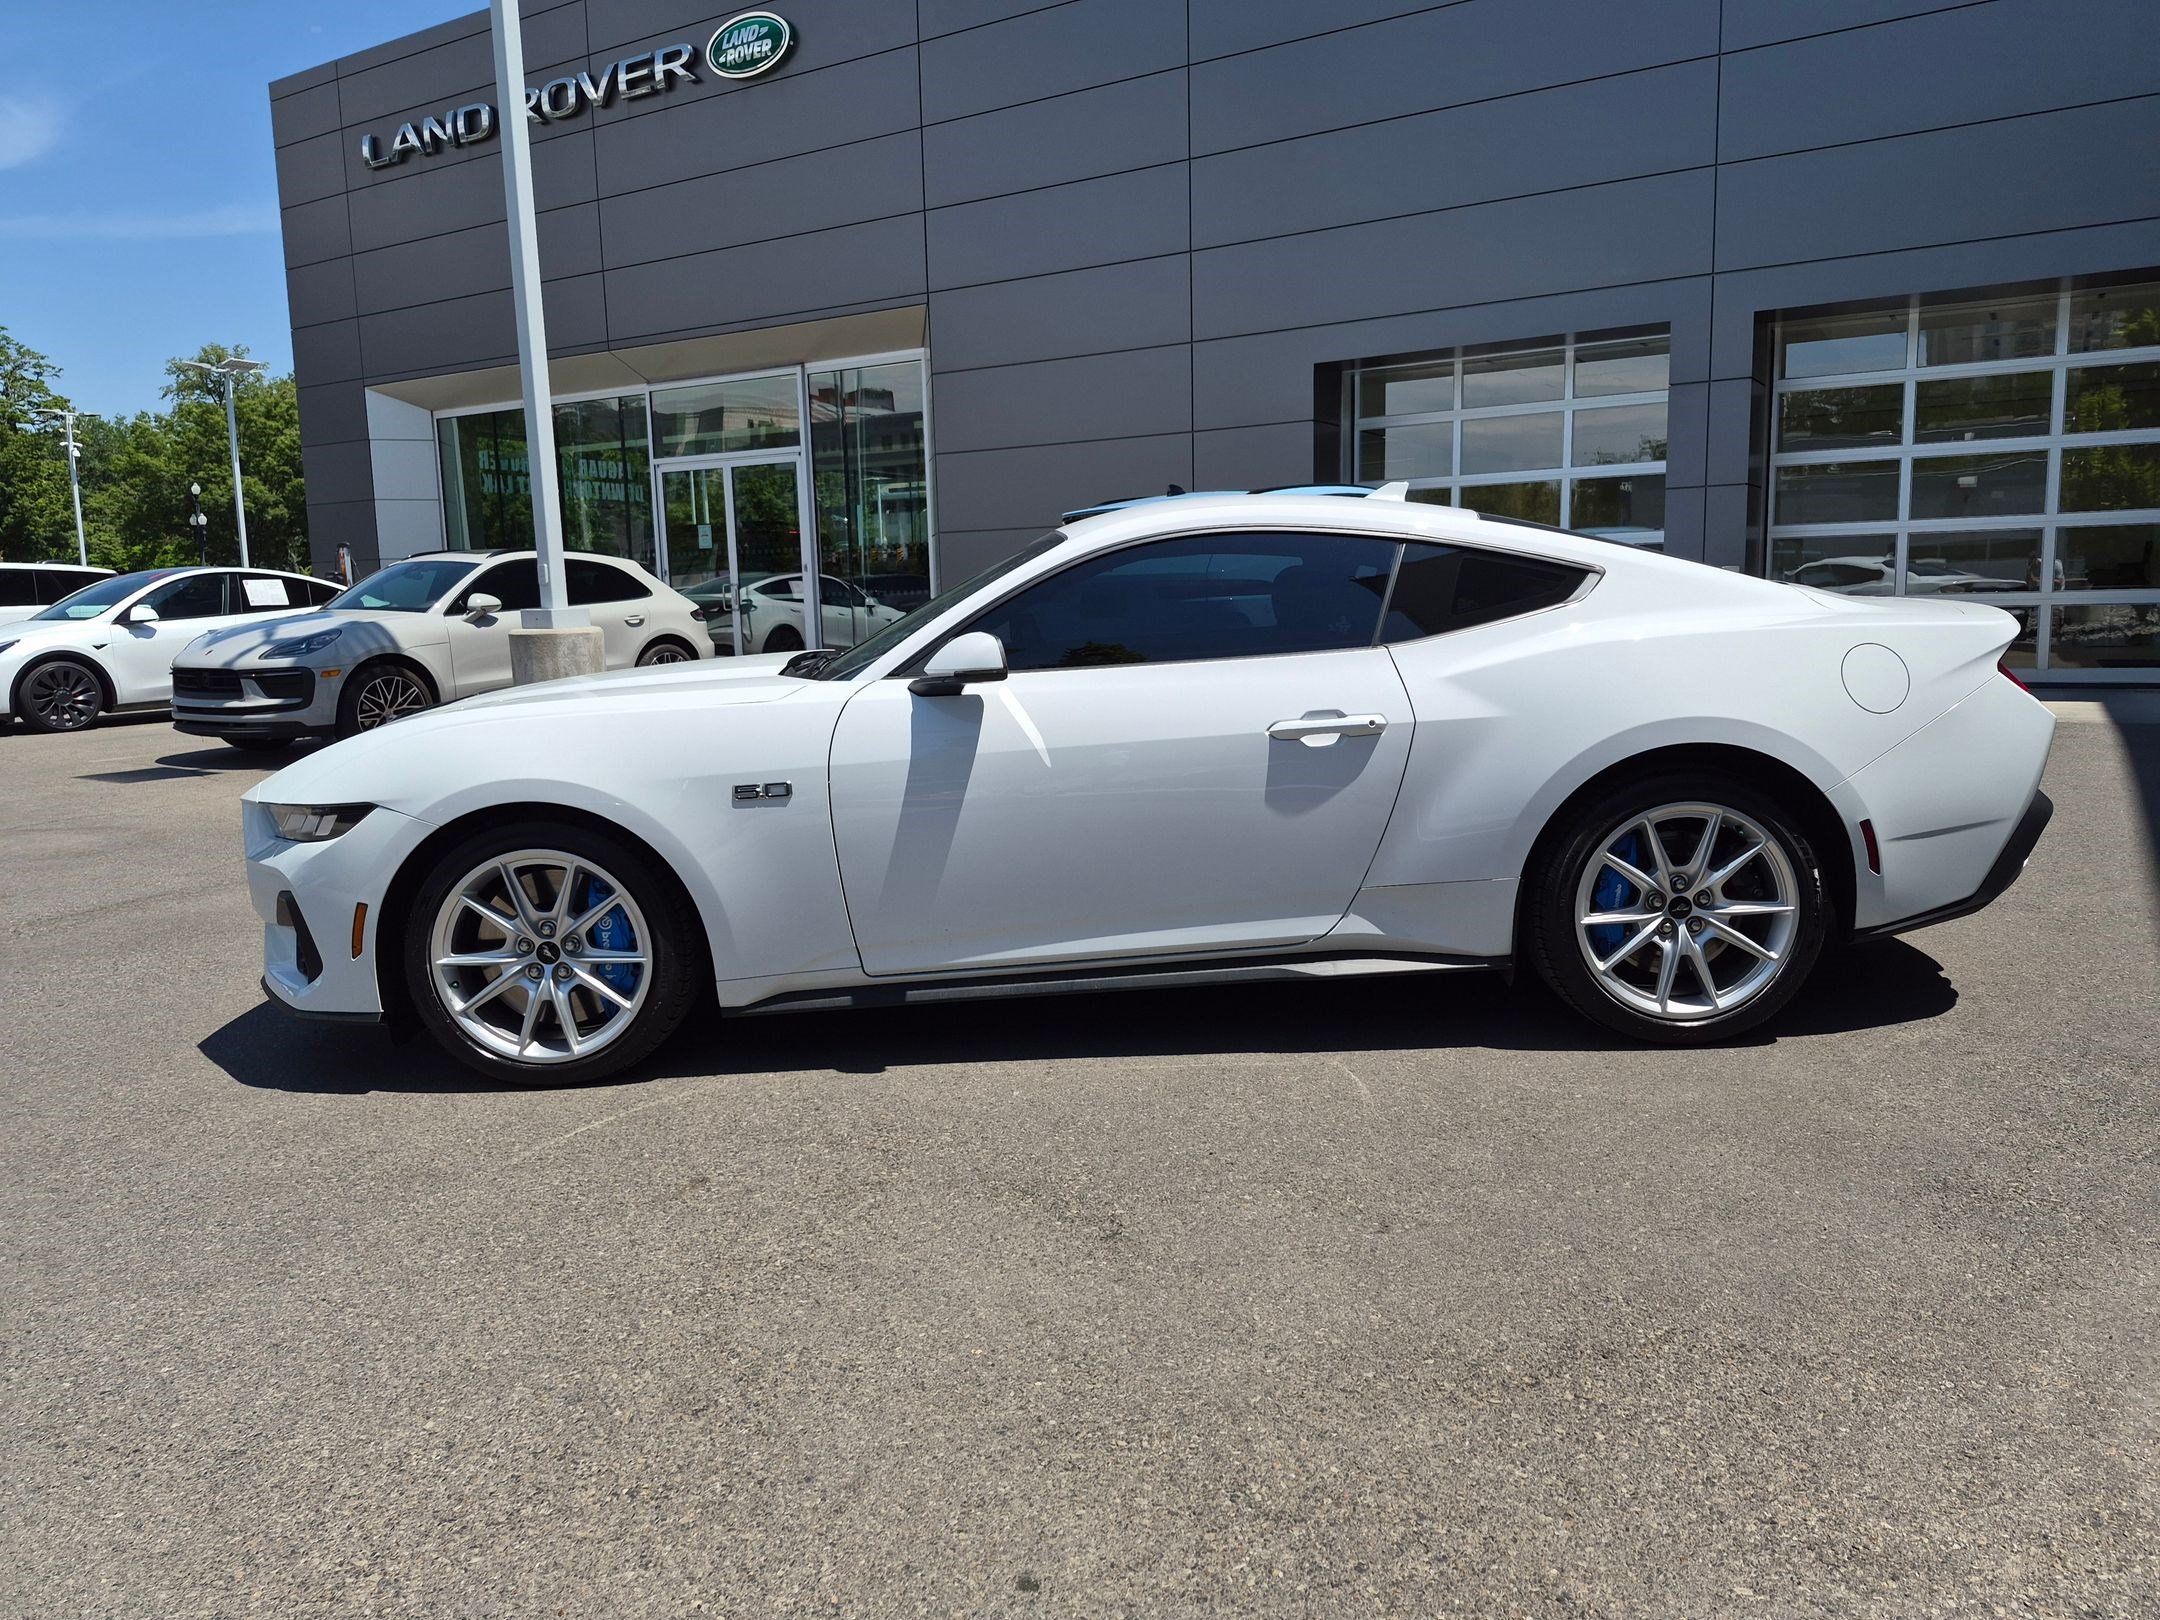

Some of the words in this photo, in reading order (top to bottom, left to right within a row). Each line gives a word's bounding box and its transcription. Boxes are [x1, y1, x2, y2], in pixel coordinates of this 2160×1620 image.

[722, 24, 759, 50] LAND
[726, 38, 772, 66] ROVER
[361, 102, 491, 169] LAND
[525, 43, 696, 124] ROVER
[732, 780, 793, 803] 5.0
[600, 931, 612, 971] breo
